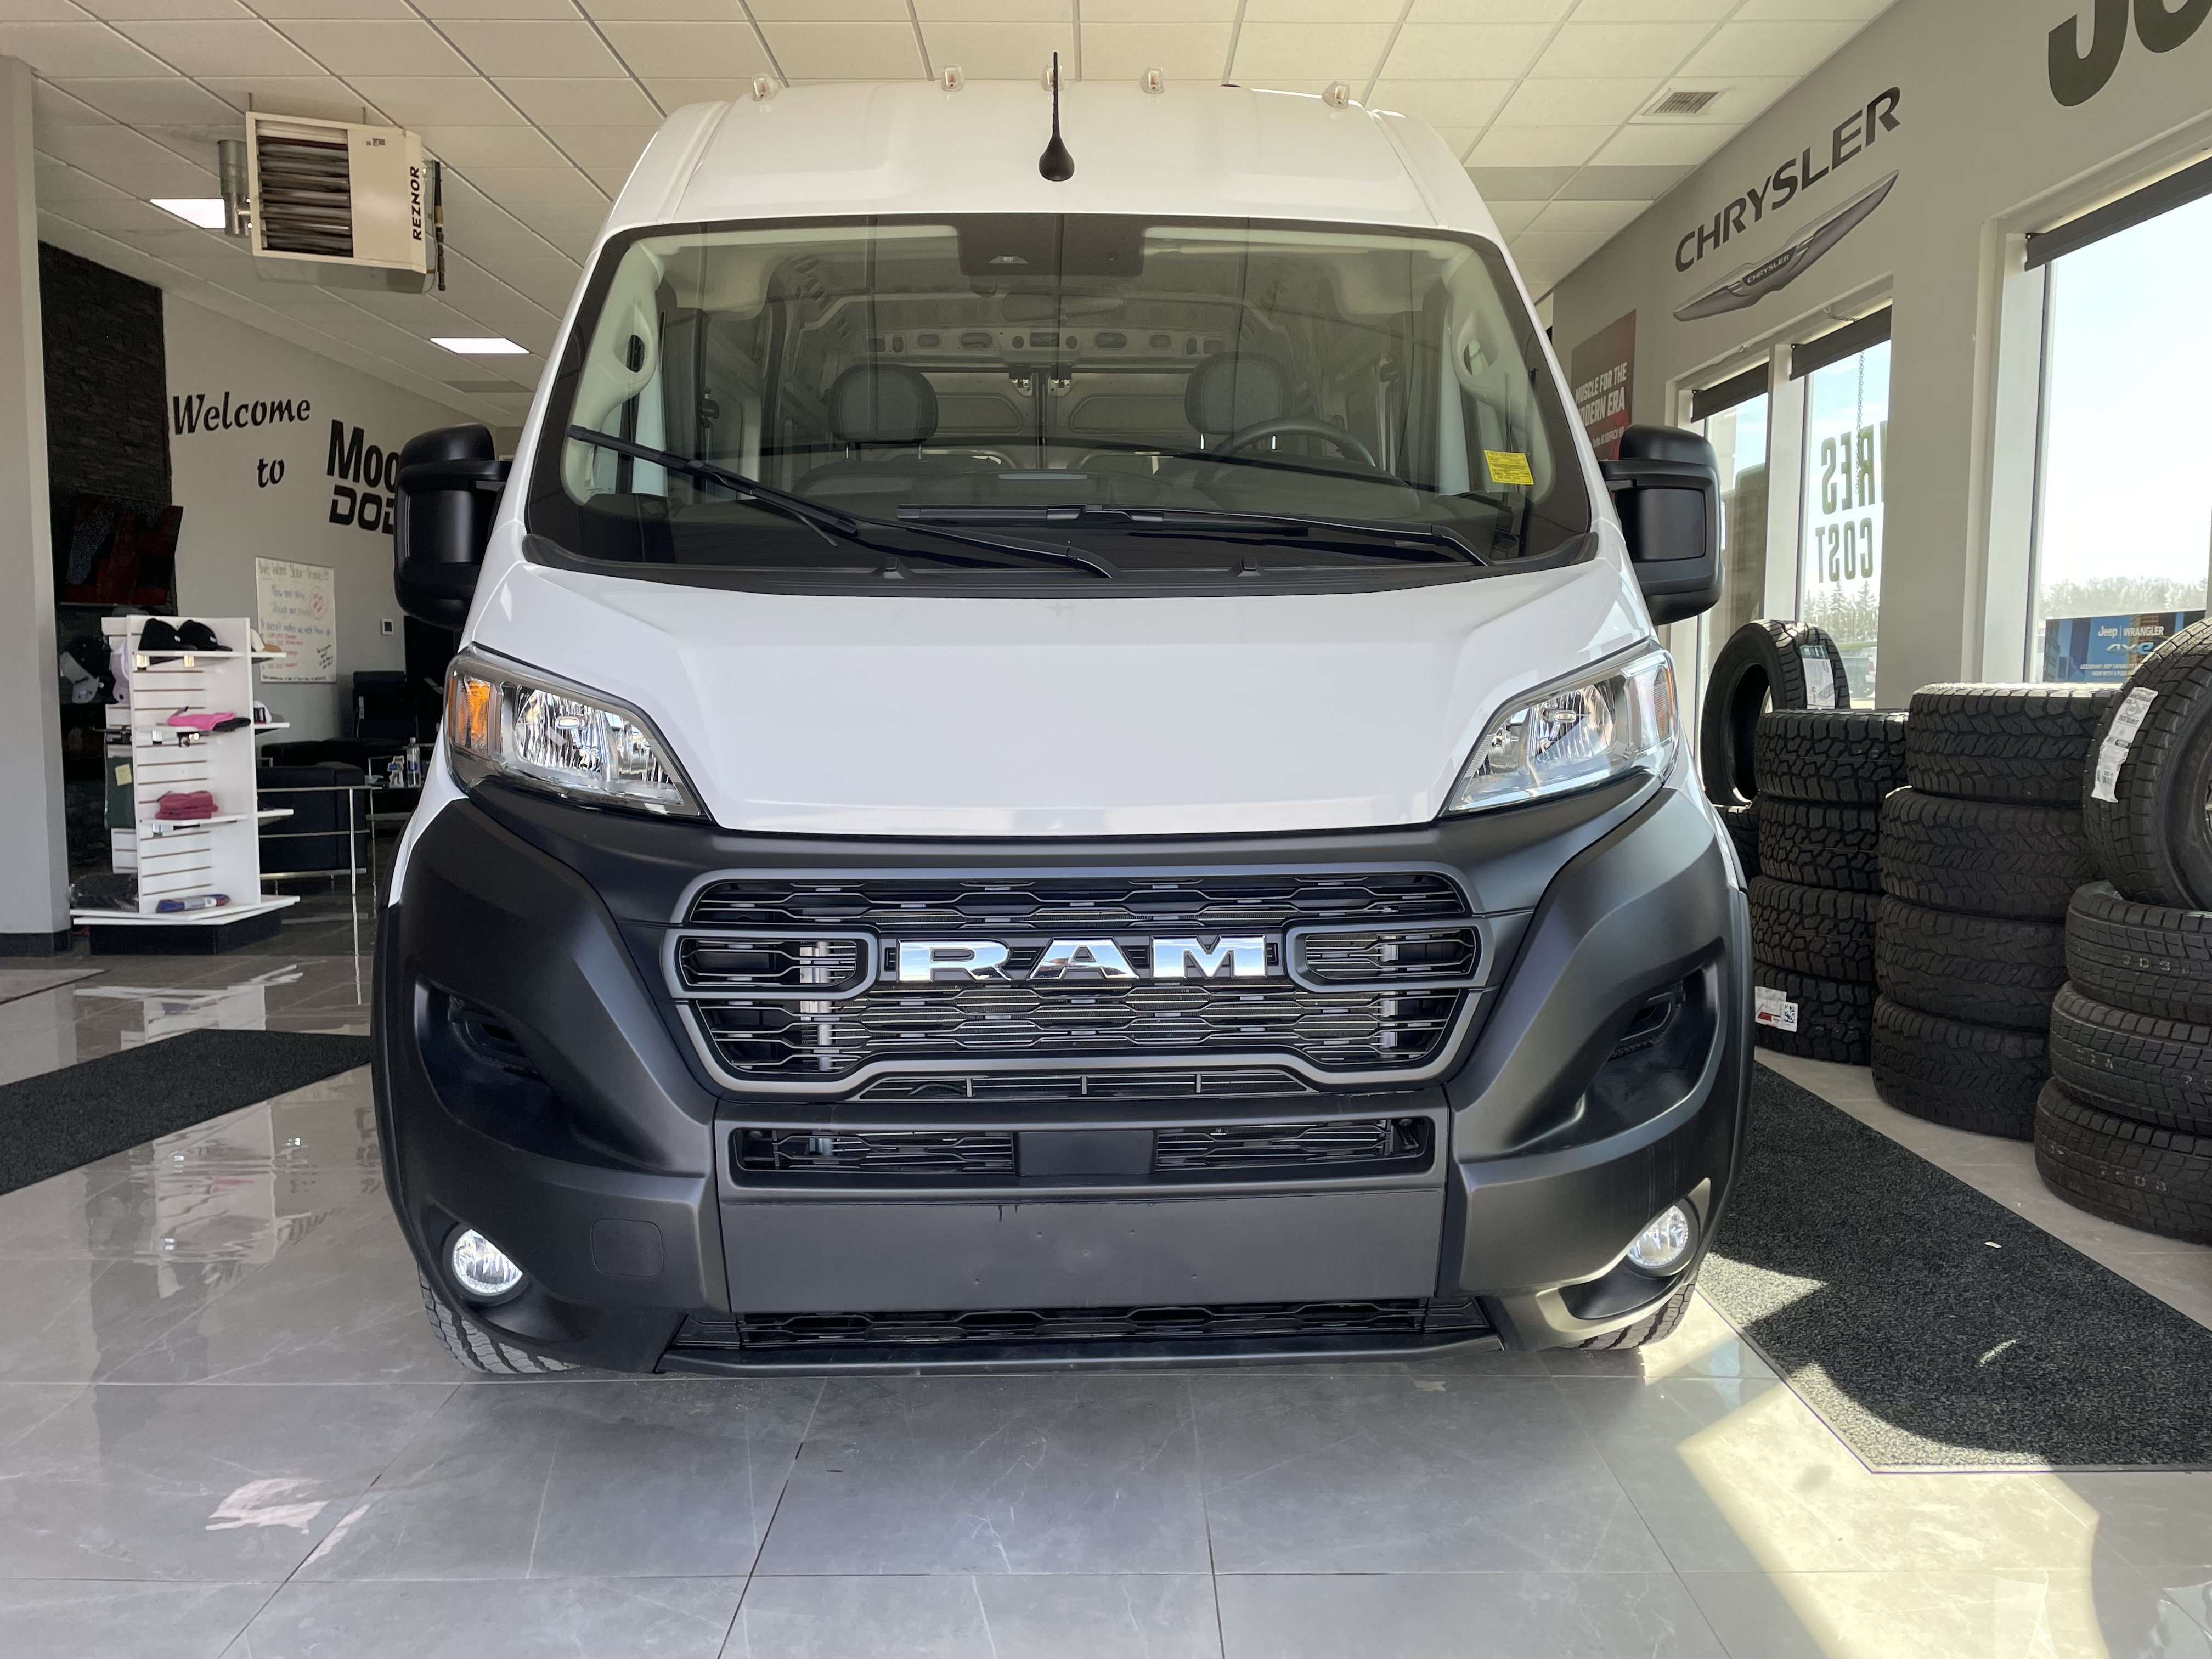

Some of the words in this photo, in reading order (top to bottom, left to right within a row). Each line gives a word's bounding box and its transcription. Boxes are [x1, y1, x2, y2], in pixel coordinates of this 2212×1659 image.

[1675, 87, 1900, 272] CHRYSLER
[410, 166, 422, 241] REZNOR
[1747, 255, 1790, 283] CHRYSLER
[1575, 376, 1599, 404] MUSCLE
[1600, 370, 1613, 393] FOR
[1614, 362, 1628, 385] THE
[173, 391, 311, 435] Welcome
[1578, 395, 1607, 427] ODERN
[1607, 386, 1625, 417] ERA
[257, 458, 285, 488] to
[2098, 625, 2118, 639] Jeep
[2124, 625, 2164, 637] WRANGLER
[896, 935, 1267, 982] RAM
